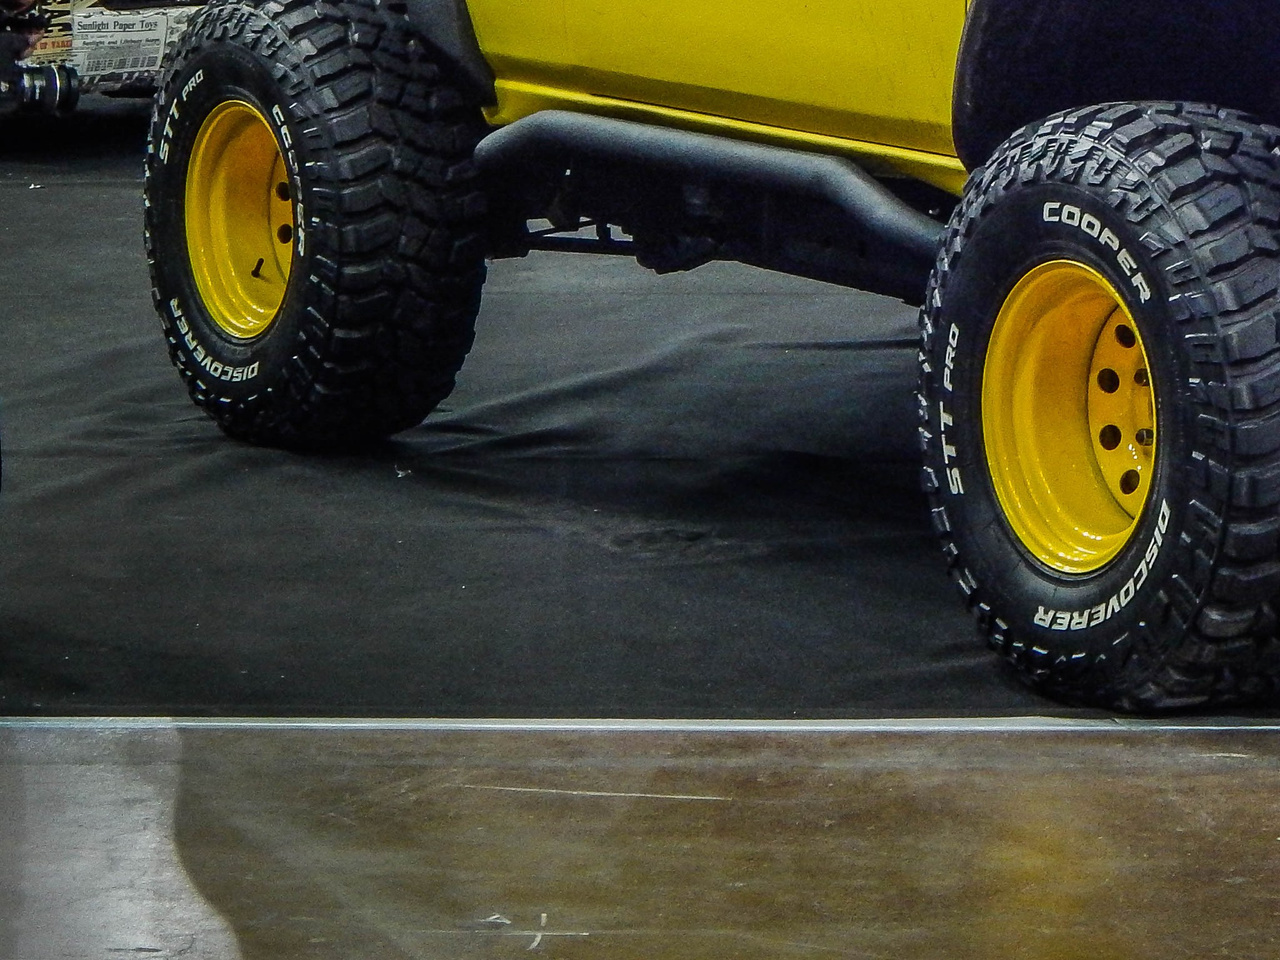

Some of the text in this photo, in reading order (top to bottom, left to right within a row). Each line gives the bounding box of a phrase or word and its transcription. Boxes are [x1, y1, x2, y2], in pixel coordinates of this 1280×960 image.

[77, 19, 158, 32] Sunlight Paper Toys
[158, 68, 205, 165] STT PRO
[1042, 200, 1152, 305] COOPER
[169, 296, 260, 384] DISCOVERER
[940, 322, 964, 496] STT PRO
[1032, 497, 1172, 633] DISCOVERER
